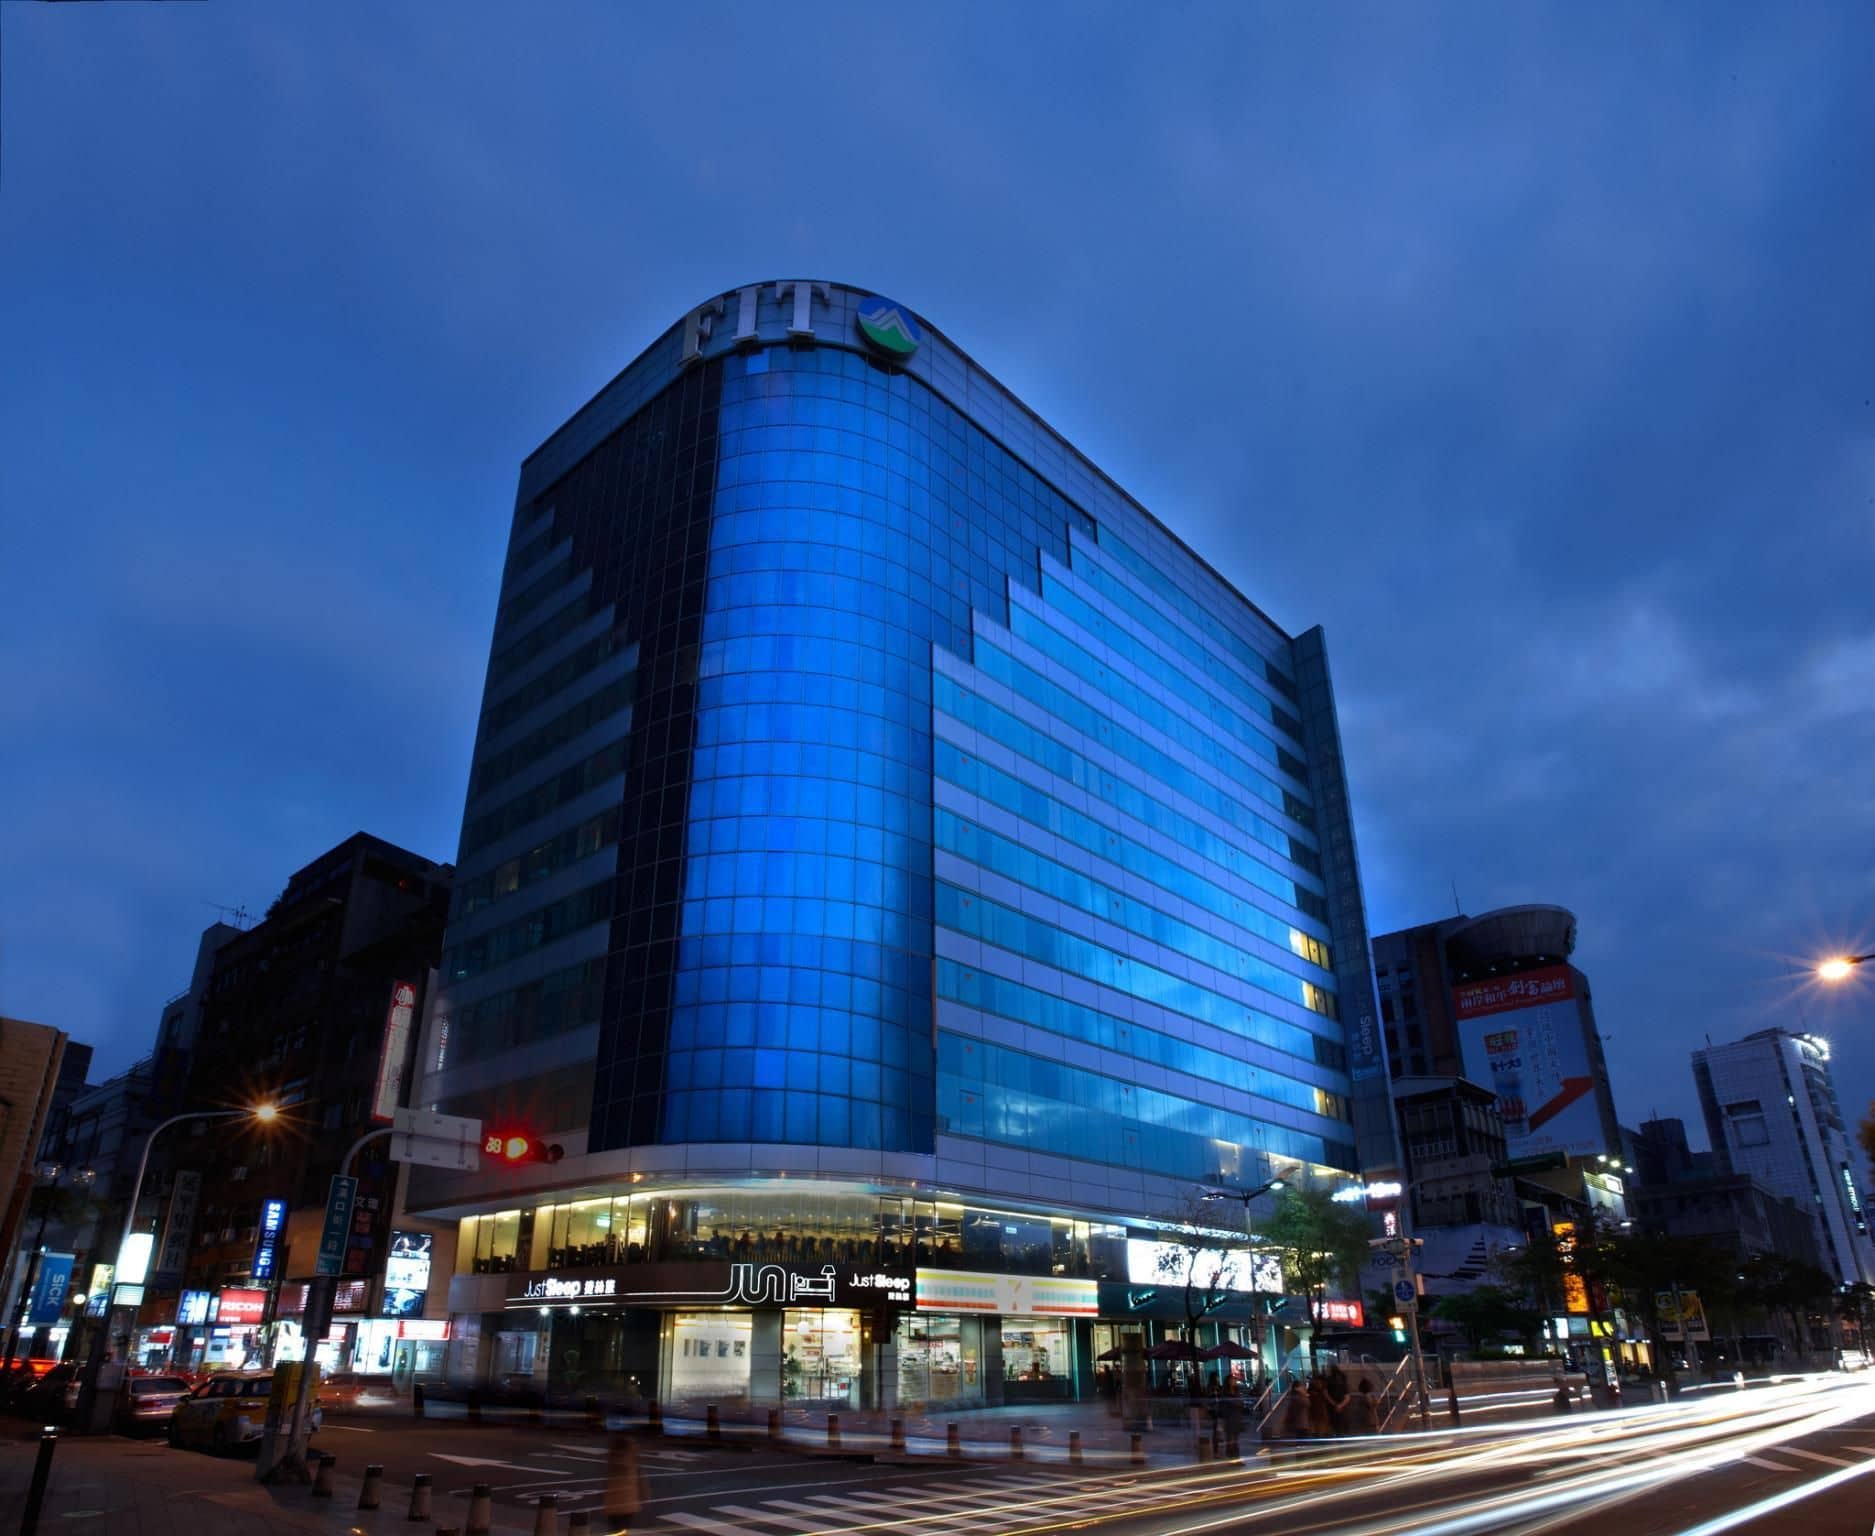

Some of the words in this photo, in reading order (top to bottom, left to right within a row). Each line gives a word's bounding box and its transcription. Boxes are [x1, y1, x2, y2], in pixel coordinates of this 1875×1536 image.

[678, 280, 831, 367] FIT
[259, 1202, 282, 1266] SAMSUNG
[47, 1273, 65, 1307] SICK
[220, 1301, 264, 1313] RICOH
